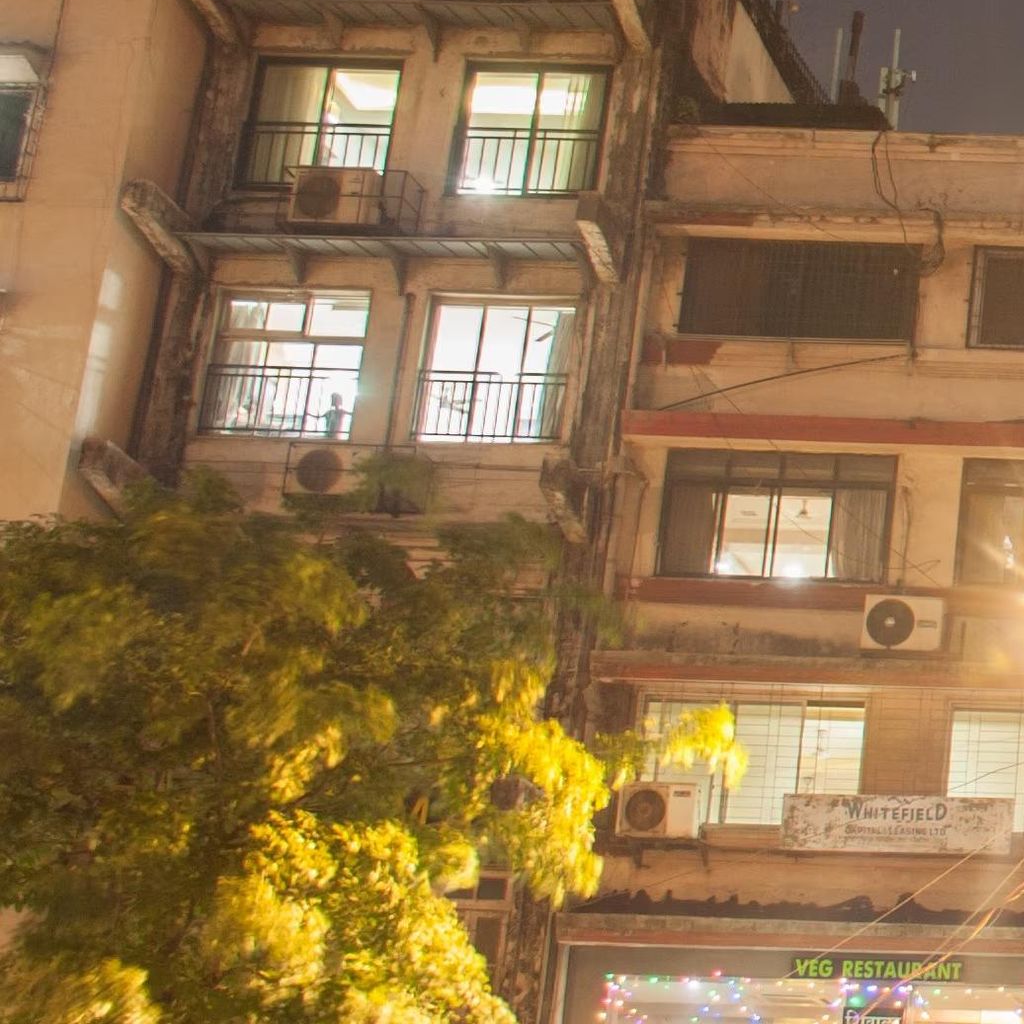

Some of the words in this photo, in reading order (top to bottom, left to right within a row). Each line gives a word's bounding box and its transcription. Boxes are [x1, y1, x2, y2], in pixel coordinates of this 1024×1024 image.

[847, 802, 947, 821] WHITEFIELD
[795, 958, 834, 977] VEG
[842, 960, 963, 980] RESTAURANT
